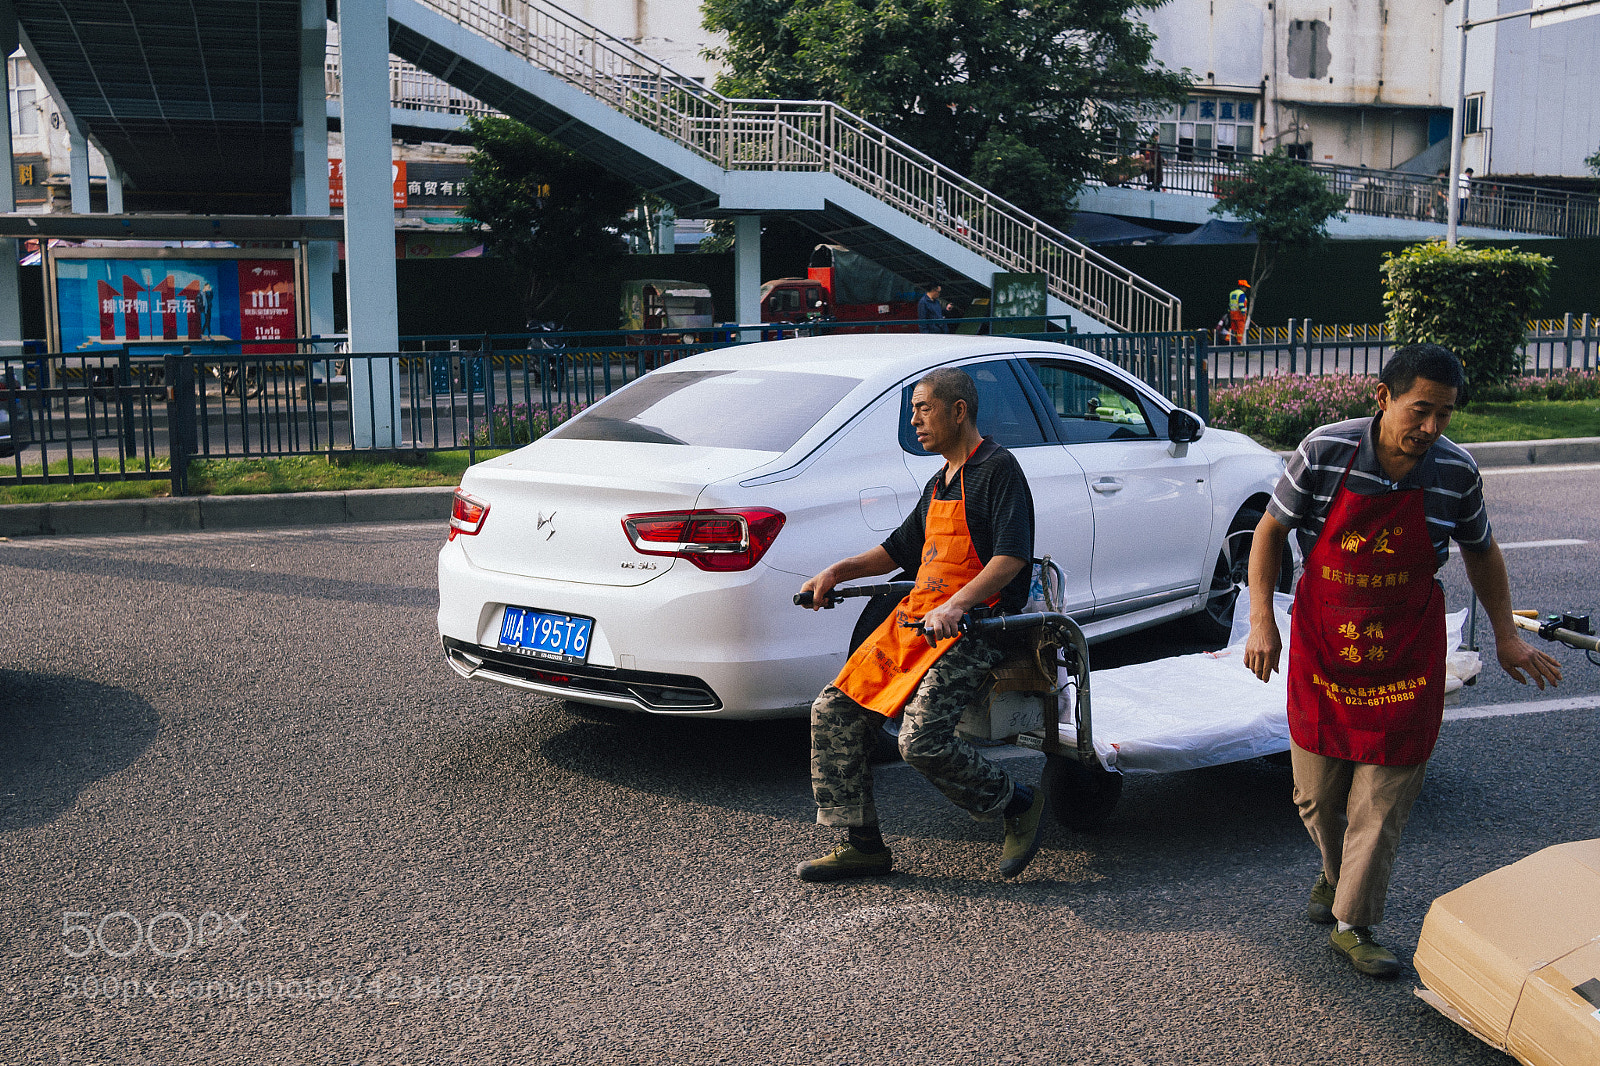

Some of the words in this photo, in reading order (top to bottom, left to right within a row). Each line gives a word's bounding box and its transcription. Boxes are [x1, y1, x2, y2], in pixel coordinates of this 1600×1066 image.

[102, 299, 148, 313] 挑好物
[152, 299, 196, 313] 上京东
[1321, 565, 1409, 588] 重庆市著名商标
[1338, 620, 1384, 640] 鸡精
[1345, 691, 1415, 706] 023-68719888
